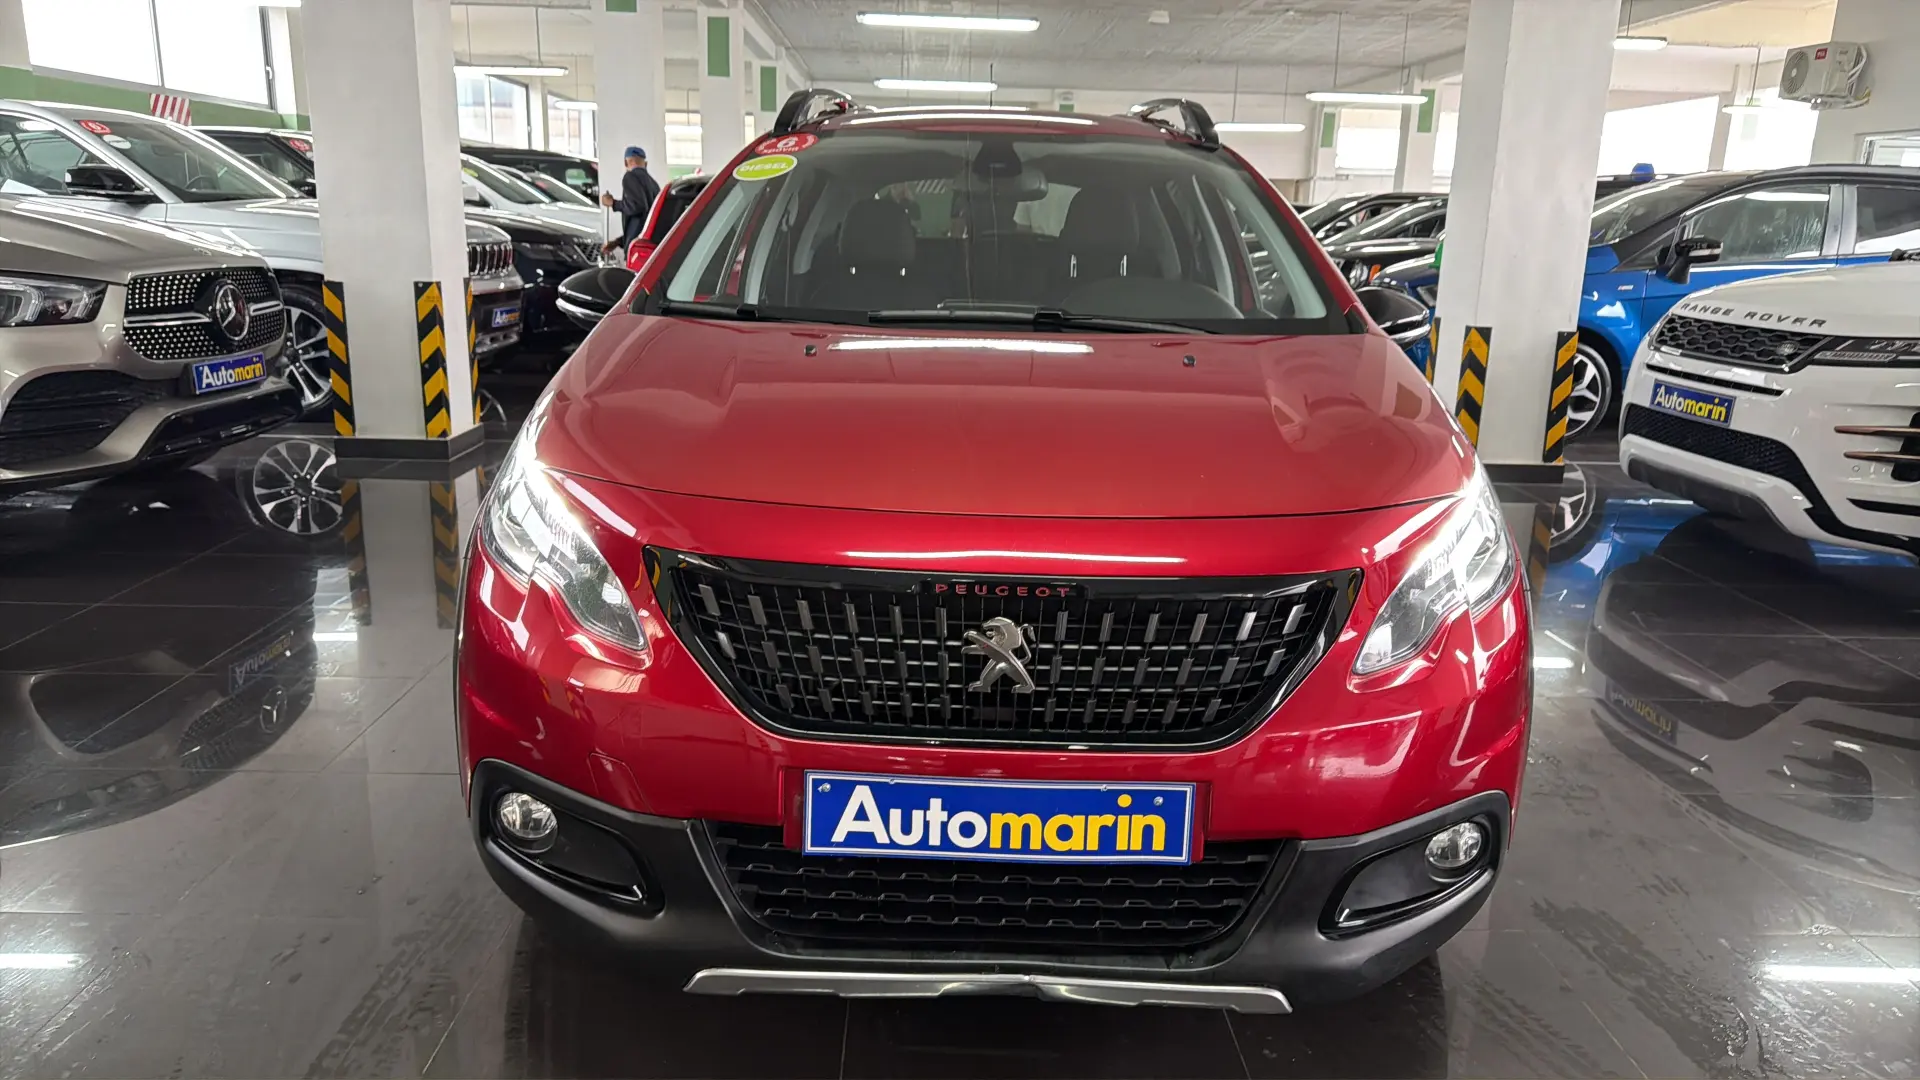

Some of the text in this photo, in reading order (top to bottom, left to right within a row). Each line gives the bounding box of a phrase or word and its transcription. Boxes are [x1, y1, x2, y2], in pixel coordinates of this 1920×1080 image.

[777, 136, 799, 148] 6
[740, 162, 788, 172] DIESEL
[1681, 303, 1827, 328] RANGE ROVER
[202, 356, 263, 388] Automarin
[1654, 385, 1726, 421] Automarin
[935, 583, 1070, 598] PEUGEOT
[831, 785, 1165, 851] Automarin
